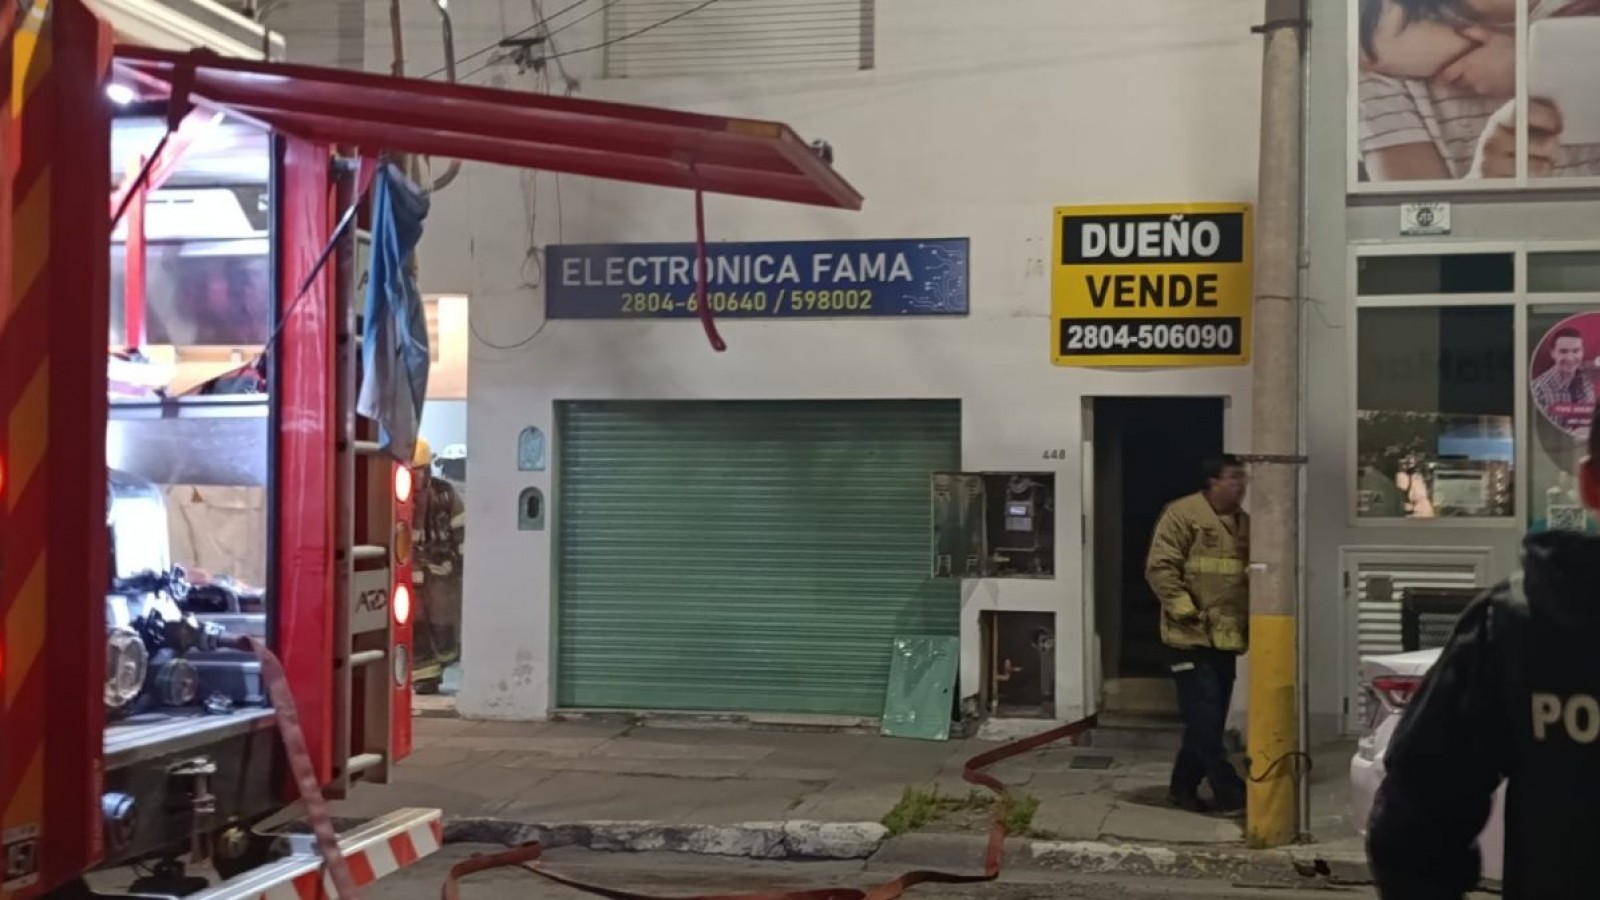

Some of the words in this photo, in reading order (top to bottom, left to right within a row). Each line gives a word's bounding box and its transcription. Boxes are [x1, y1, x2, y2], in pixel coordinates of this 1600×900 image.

[1081, 214, 1221, 258] DUEÑO
[562, 253, 800, 287] ELECTRONICA
[812, 252, 912, 283] FAMA
[791, 289, 872, 311] 598002
[1085, 274, 1218, 308] VENDE
[1067, 323, 1233, 349] 2804-506090
[1531, 692, 1600, 743] PO
